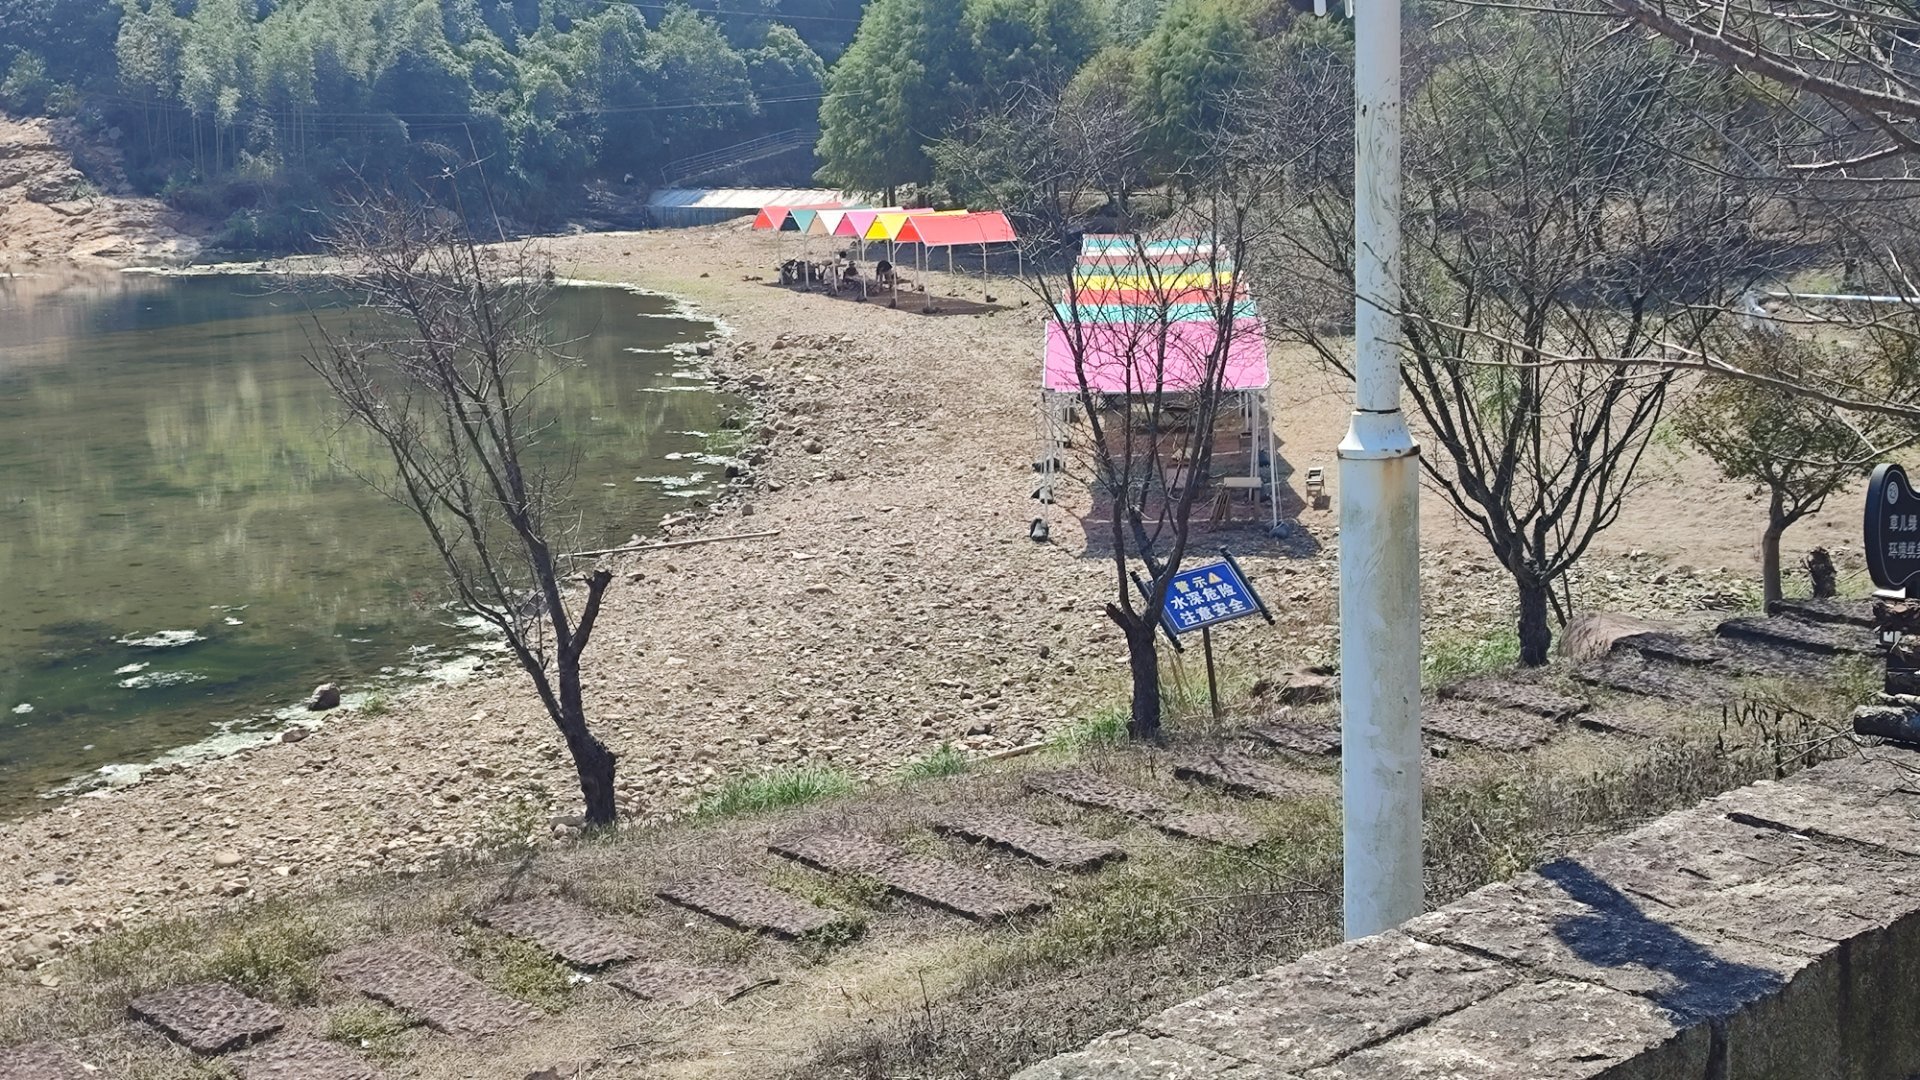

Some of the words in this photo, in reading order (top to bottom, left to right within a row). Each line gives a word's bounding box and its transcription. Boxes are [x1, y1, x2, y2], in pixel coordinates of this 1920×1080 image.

[1171, 582, 1237, 610] 水深危险
[1174, 576, 1207, 593] 警示
[1180, 598, 1246, 626] 注意安全
